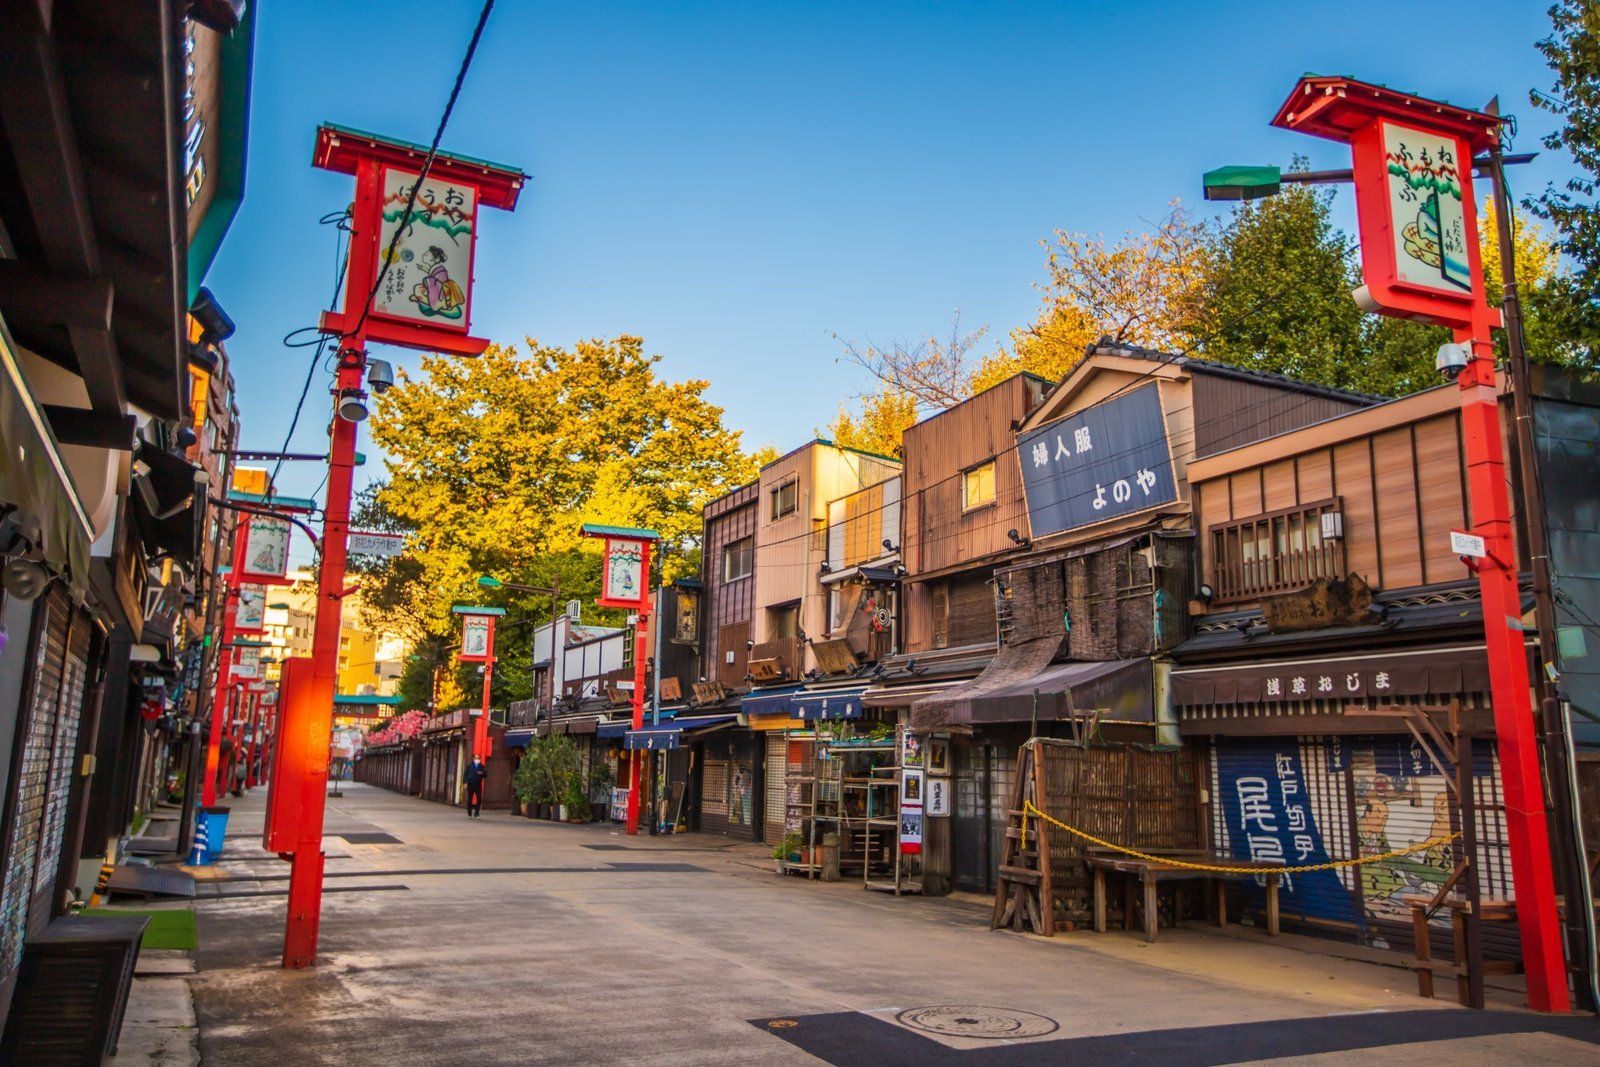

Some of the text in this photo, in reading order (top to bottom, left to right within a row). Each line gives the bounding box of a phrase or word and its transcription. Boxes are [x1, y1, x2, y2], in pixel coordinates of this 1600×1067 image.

[1032, 426, 1093, 468] 婦人服
[1092, 467, 1157, 510] よのや
[1266, 671, 1391, 696] 浅草おじま
